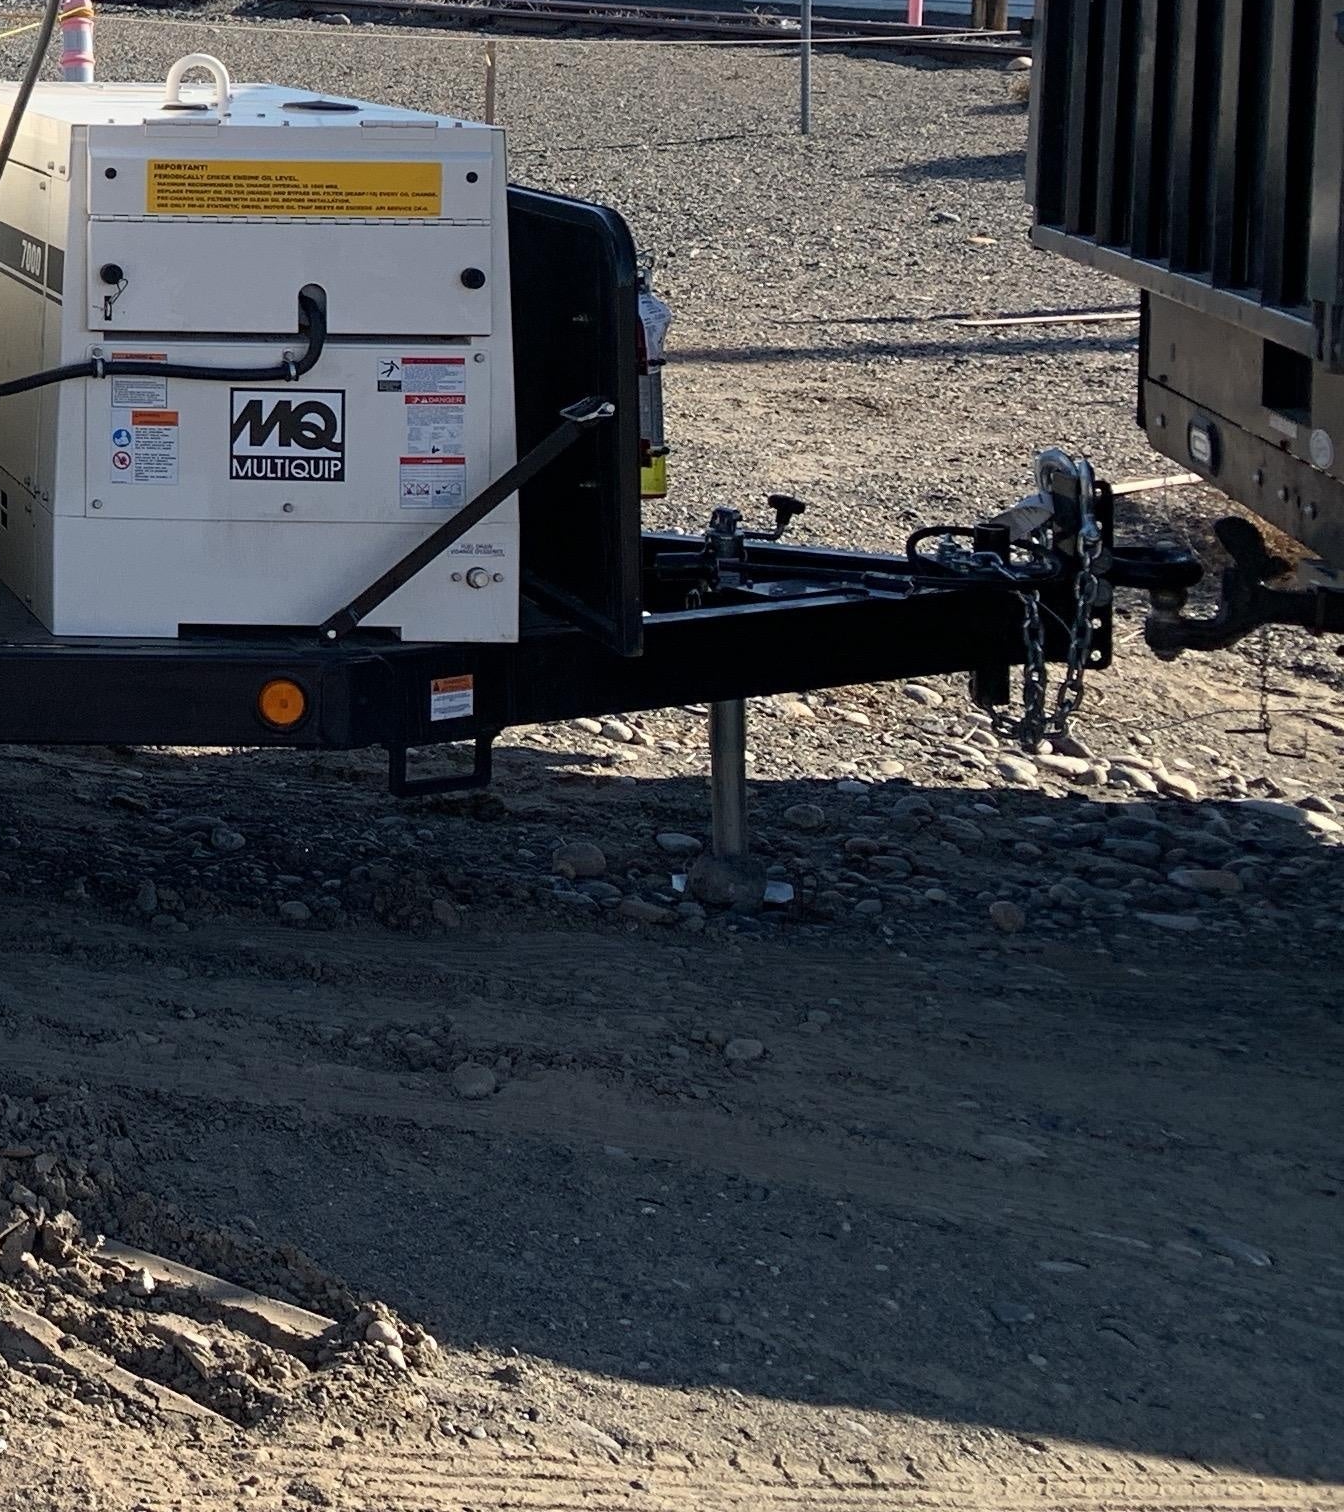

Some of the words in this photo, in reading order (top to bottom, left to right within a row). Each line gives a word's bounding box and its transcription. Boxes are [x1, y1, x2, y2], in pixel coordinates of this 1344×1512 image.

[154, 163, 208, 171] IMPORTANT!
[154, 173, 204, 181] PERIODICALLY
[20, 239, 42, 276] 7000
[428, 396, 463, 404] DANGER
[232, 399, 342, 452] MQ
[232, 458, 342, 479] MULTIQUIP
